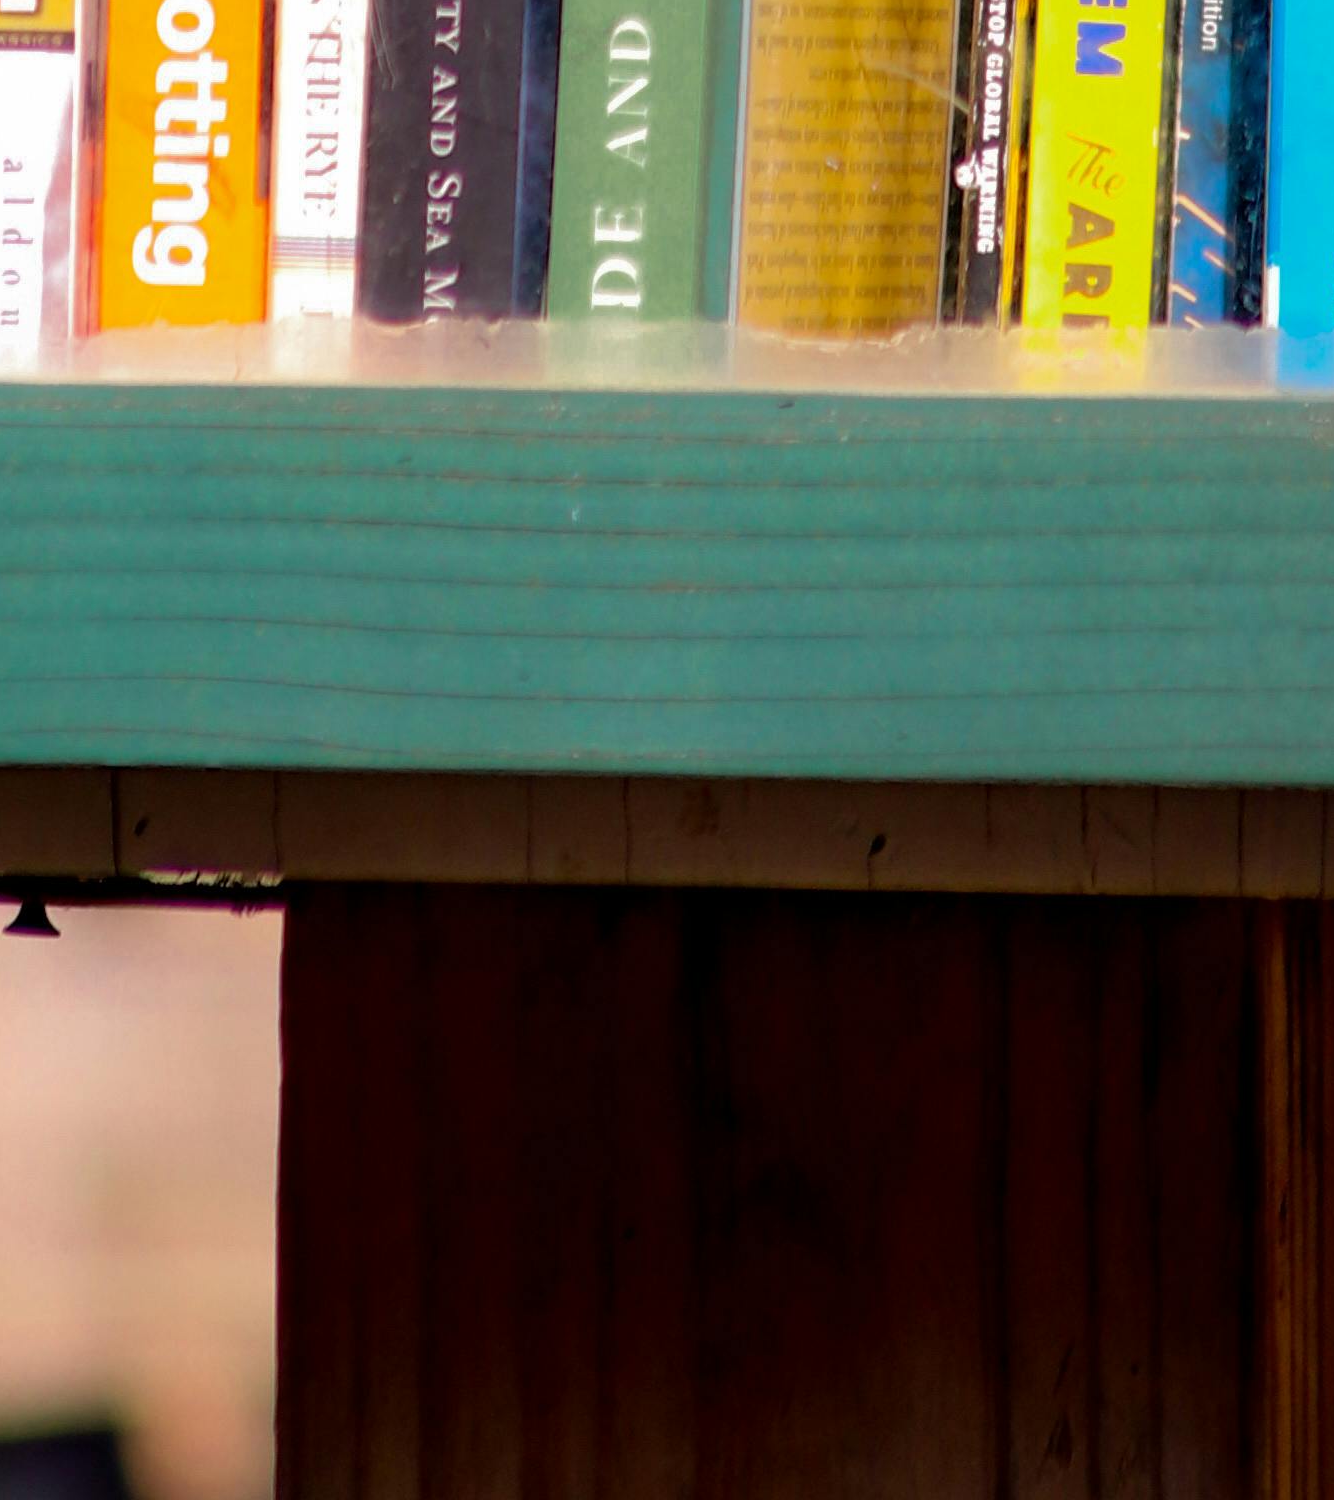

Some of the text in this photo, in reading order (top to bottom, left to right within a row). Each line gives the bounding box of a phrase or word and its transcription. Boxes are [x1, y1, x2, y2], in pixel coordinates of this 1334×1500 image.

[303, 16, 343, 120] THE
[425, 65, 461, 158] AND
[602, 17, 651, 170] AND
[981, 52, 1005, 142] GLOBAL
[300, 132, 340, 222] RYE
[975, 145, 1001, 256] WARNING
[1065, 130, 1127, 200] The
[422, 170, 463, 255] SEA
[421, 269, 459, 324] M
